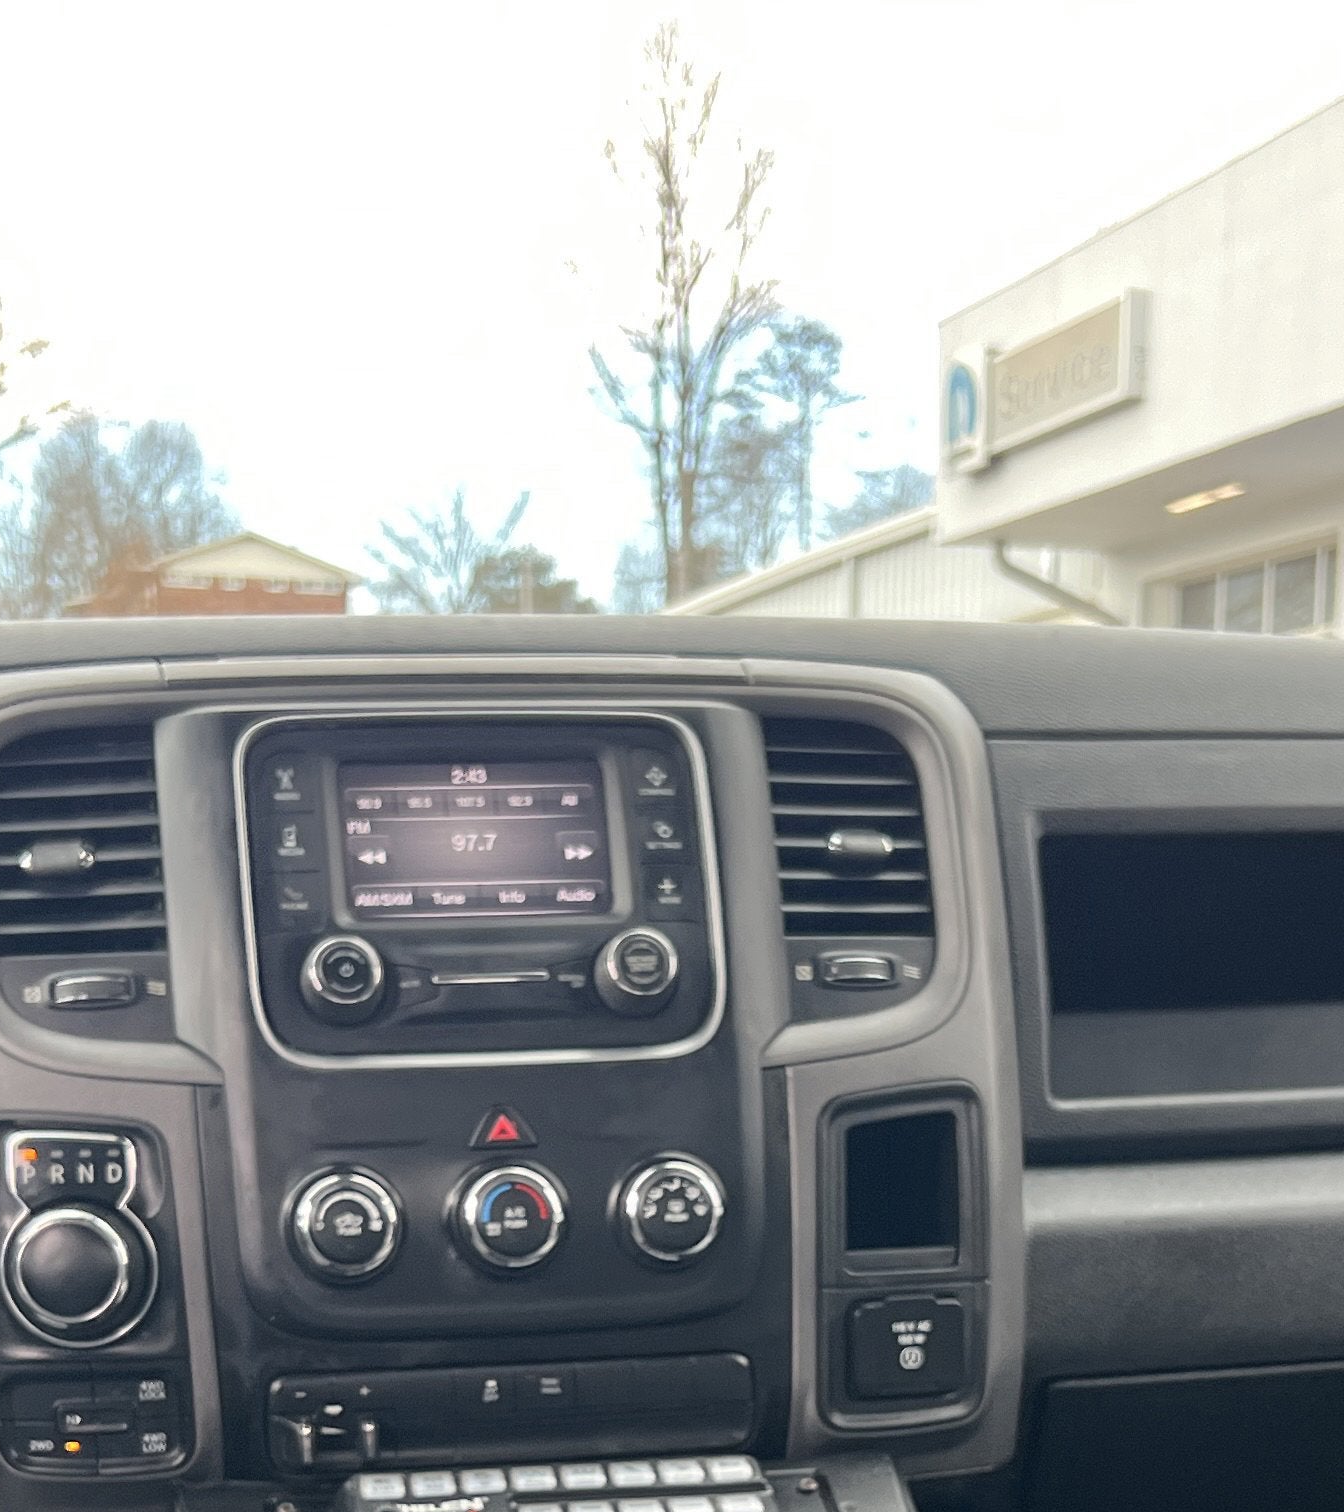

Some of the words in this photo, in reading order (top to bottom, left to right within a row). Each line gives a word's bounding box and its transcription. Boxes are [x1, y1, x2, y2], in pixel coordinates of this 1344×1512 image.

[451, 834, 497, 852] 97.7
[22, 1163, 36, 1184] P
[49, 1163, 65, 1185] R
[77, 1163, 94, 1184] N
[105, 1162, 123, 1184] D
